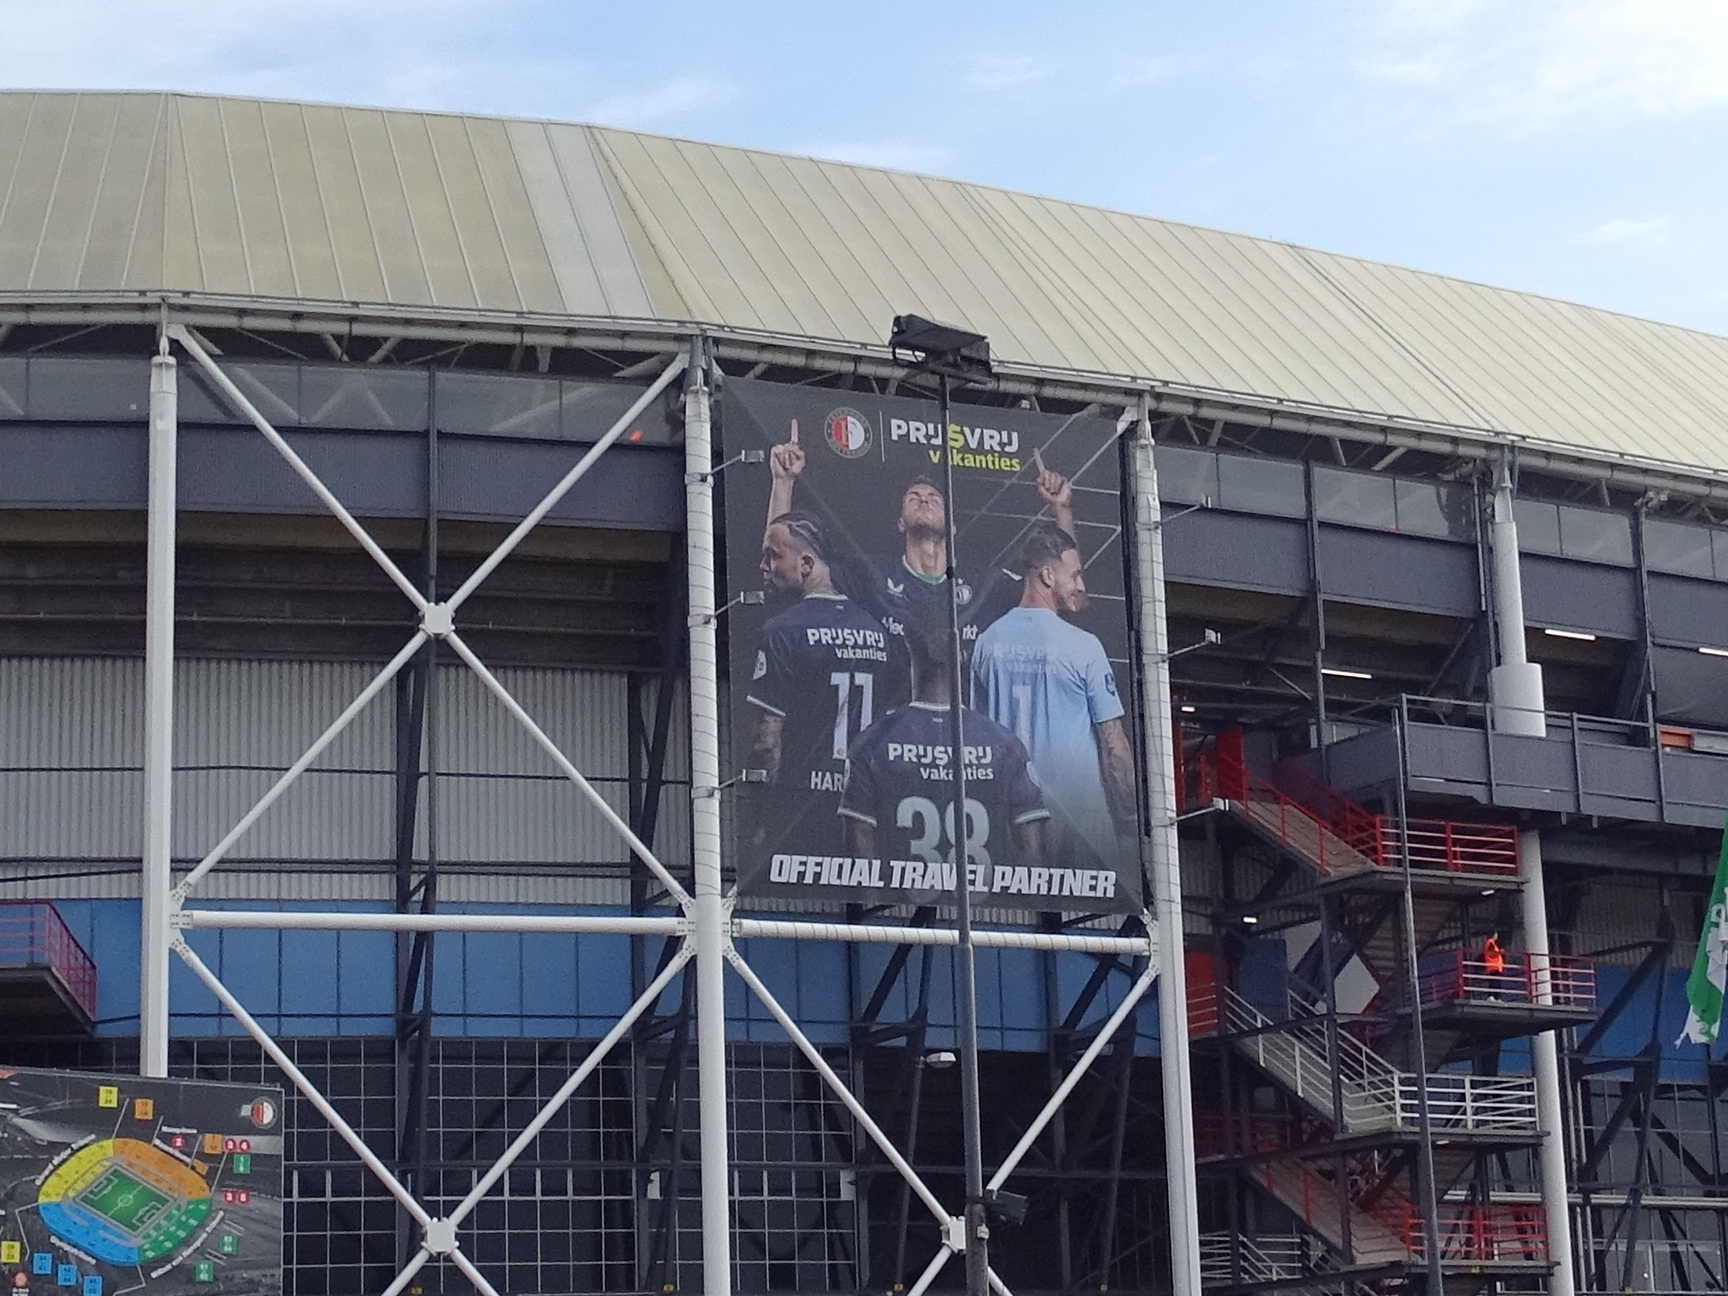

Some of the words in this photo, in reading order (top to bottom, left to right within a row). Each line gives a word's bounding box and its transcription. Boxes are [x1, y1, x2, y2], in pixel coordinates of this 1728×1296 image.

[929, 449, 1021, 471] vkanties
[835, 647, 887, 662] vakanties
[888, 743, 993, 765] PRIJSRIJ
[769, 854, 884, 887] OFFICIAL
[992, 865, 1117, 898] PARTNER
